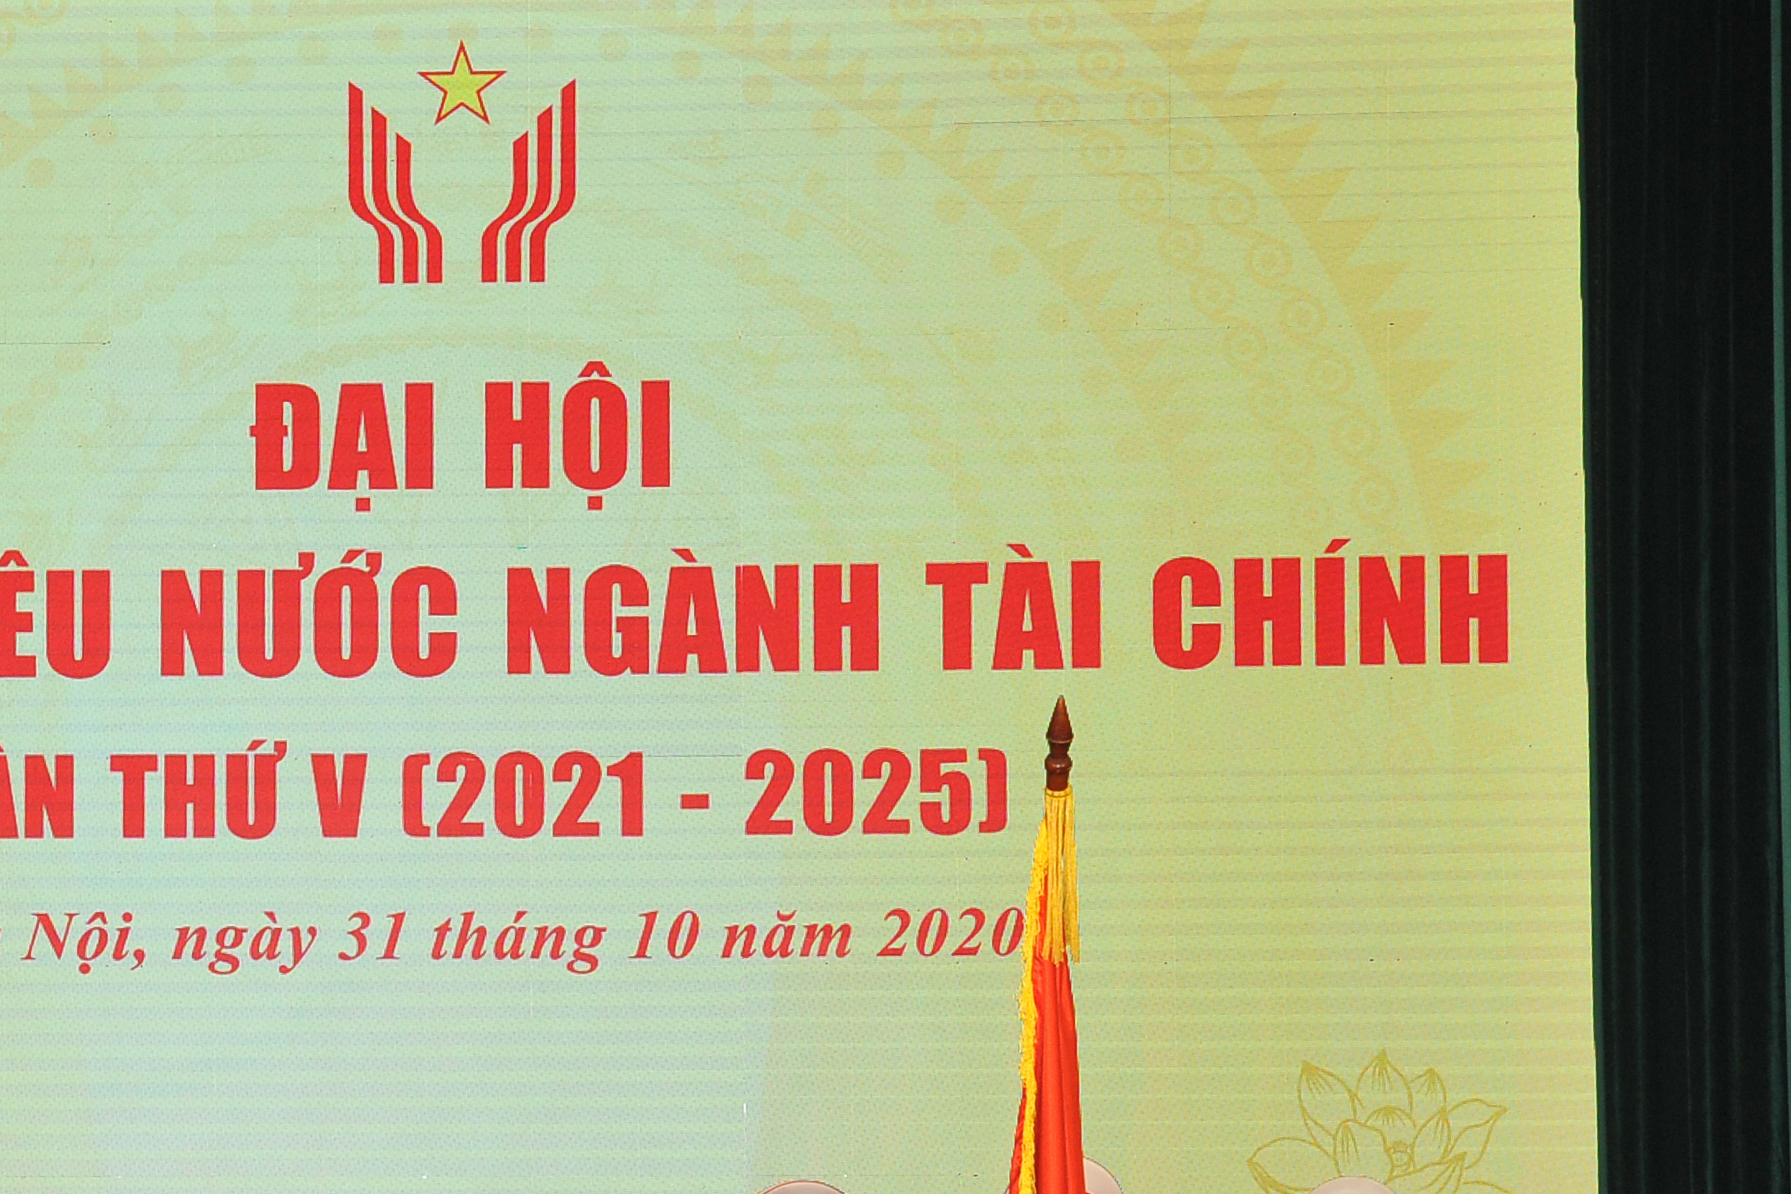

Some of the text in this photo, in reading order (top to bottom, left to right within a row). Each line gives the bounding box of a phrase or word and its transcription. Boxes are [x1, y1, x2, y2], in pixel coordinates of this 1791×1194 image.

[249, 360, 671, 513] ĐẠI HỘI
[160, 548, 459, 679] NƯỚC
[507, 548, 880, 677] NGÀNH
[925, 543, 1103, 671] TÀI
[1152, 537, 1510, 671] CHÍNH
[109, 739, 288, 840] THỨ
[311, 753, 368, 839] V
[402, 750, 645, 839] (2021
[680, 793, 711, 810] -
[745, 747, 1009, 837] 2025)
[23, 911, 146, 975] Nội,
[173, 911, 318, 975] ngày
[339, 911, 406, 961] 31
[432, 910, 607, 974] tháng
[629, 910, 701, 960] 10
[722, 911, 852, 959] năm
[877, 906, 1024, 958] 2020
